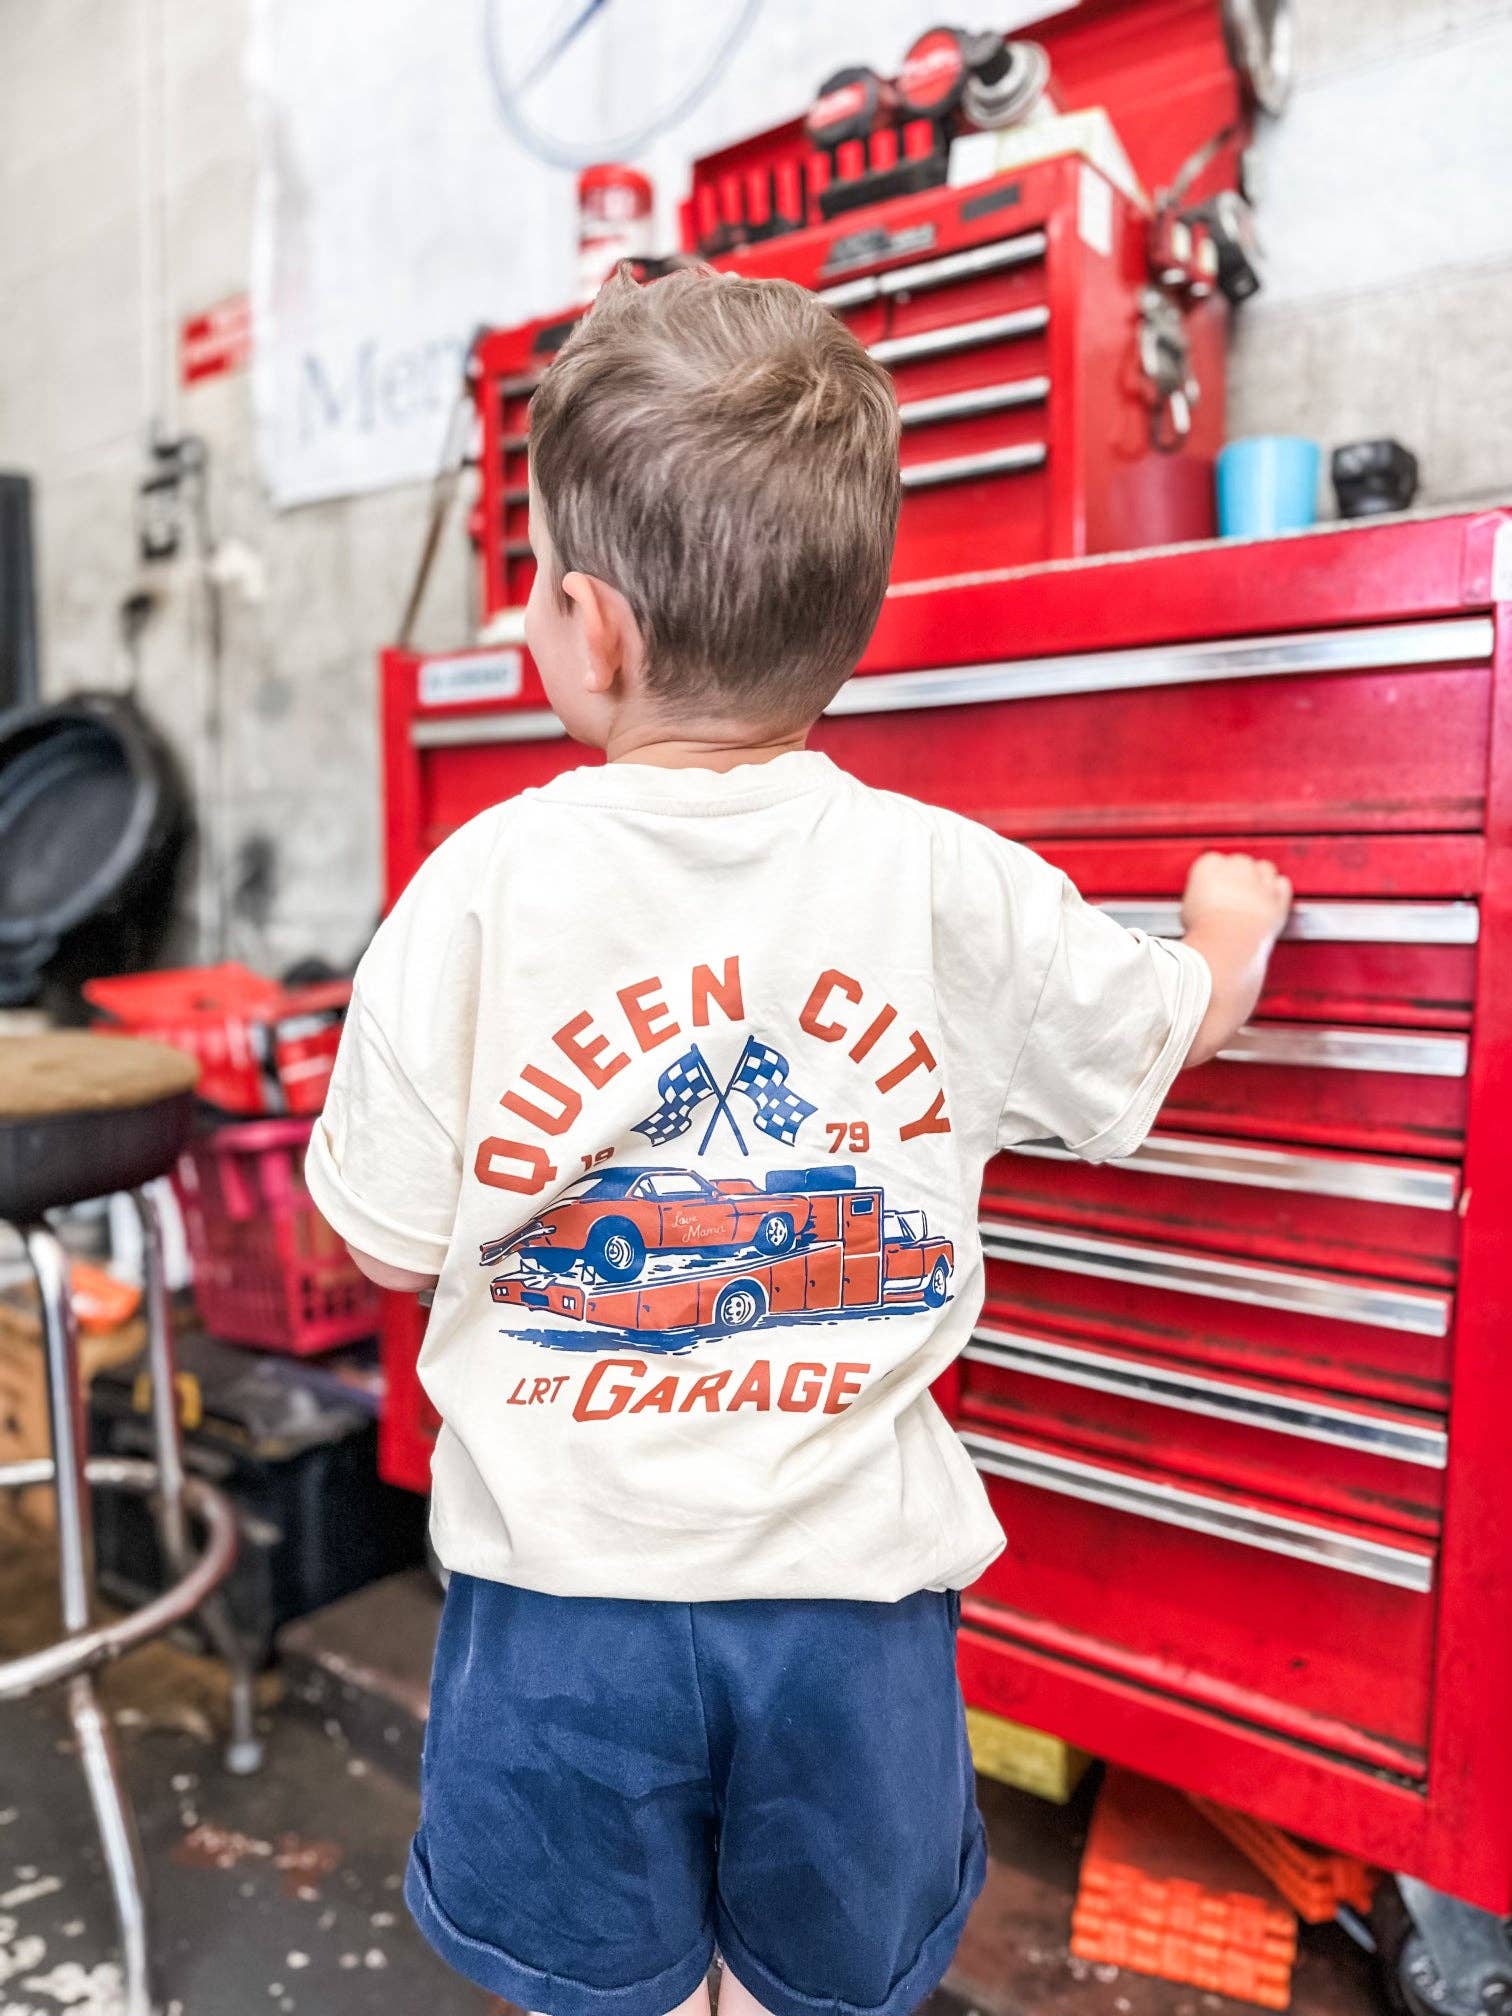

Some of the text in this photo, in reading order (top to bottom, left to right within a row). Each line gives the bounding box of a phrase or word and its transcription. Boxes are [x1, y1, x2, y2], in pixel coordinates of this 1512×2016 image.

[474, 956, 951, 1196] QUEEN CITY
[581, 1122, 869, 1172] 19 79
[506, 1358, 871, 1423] LRT GARAGE
